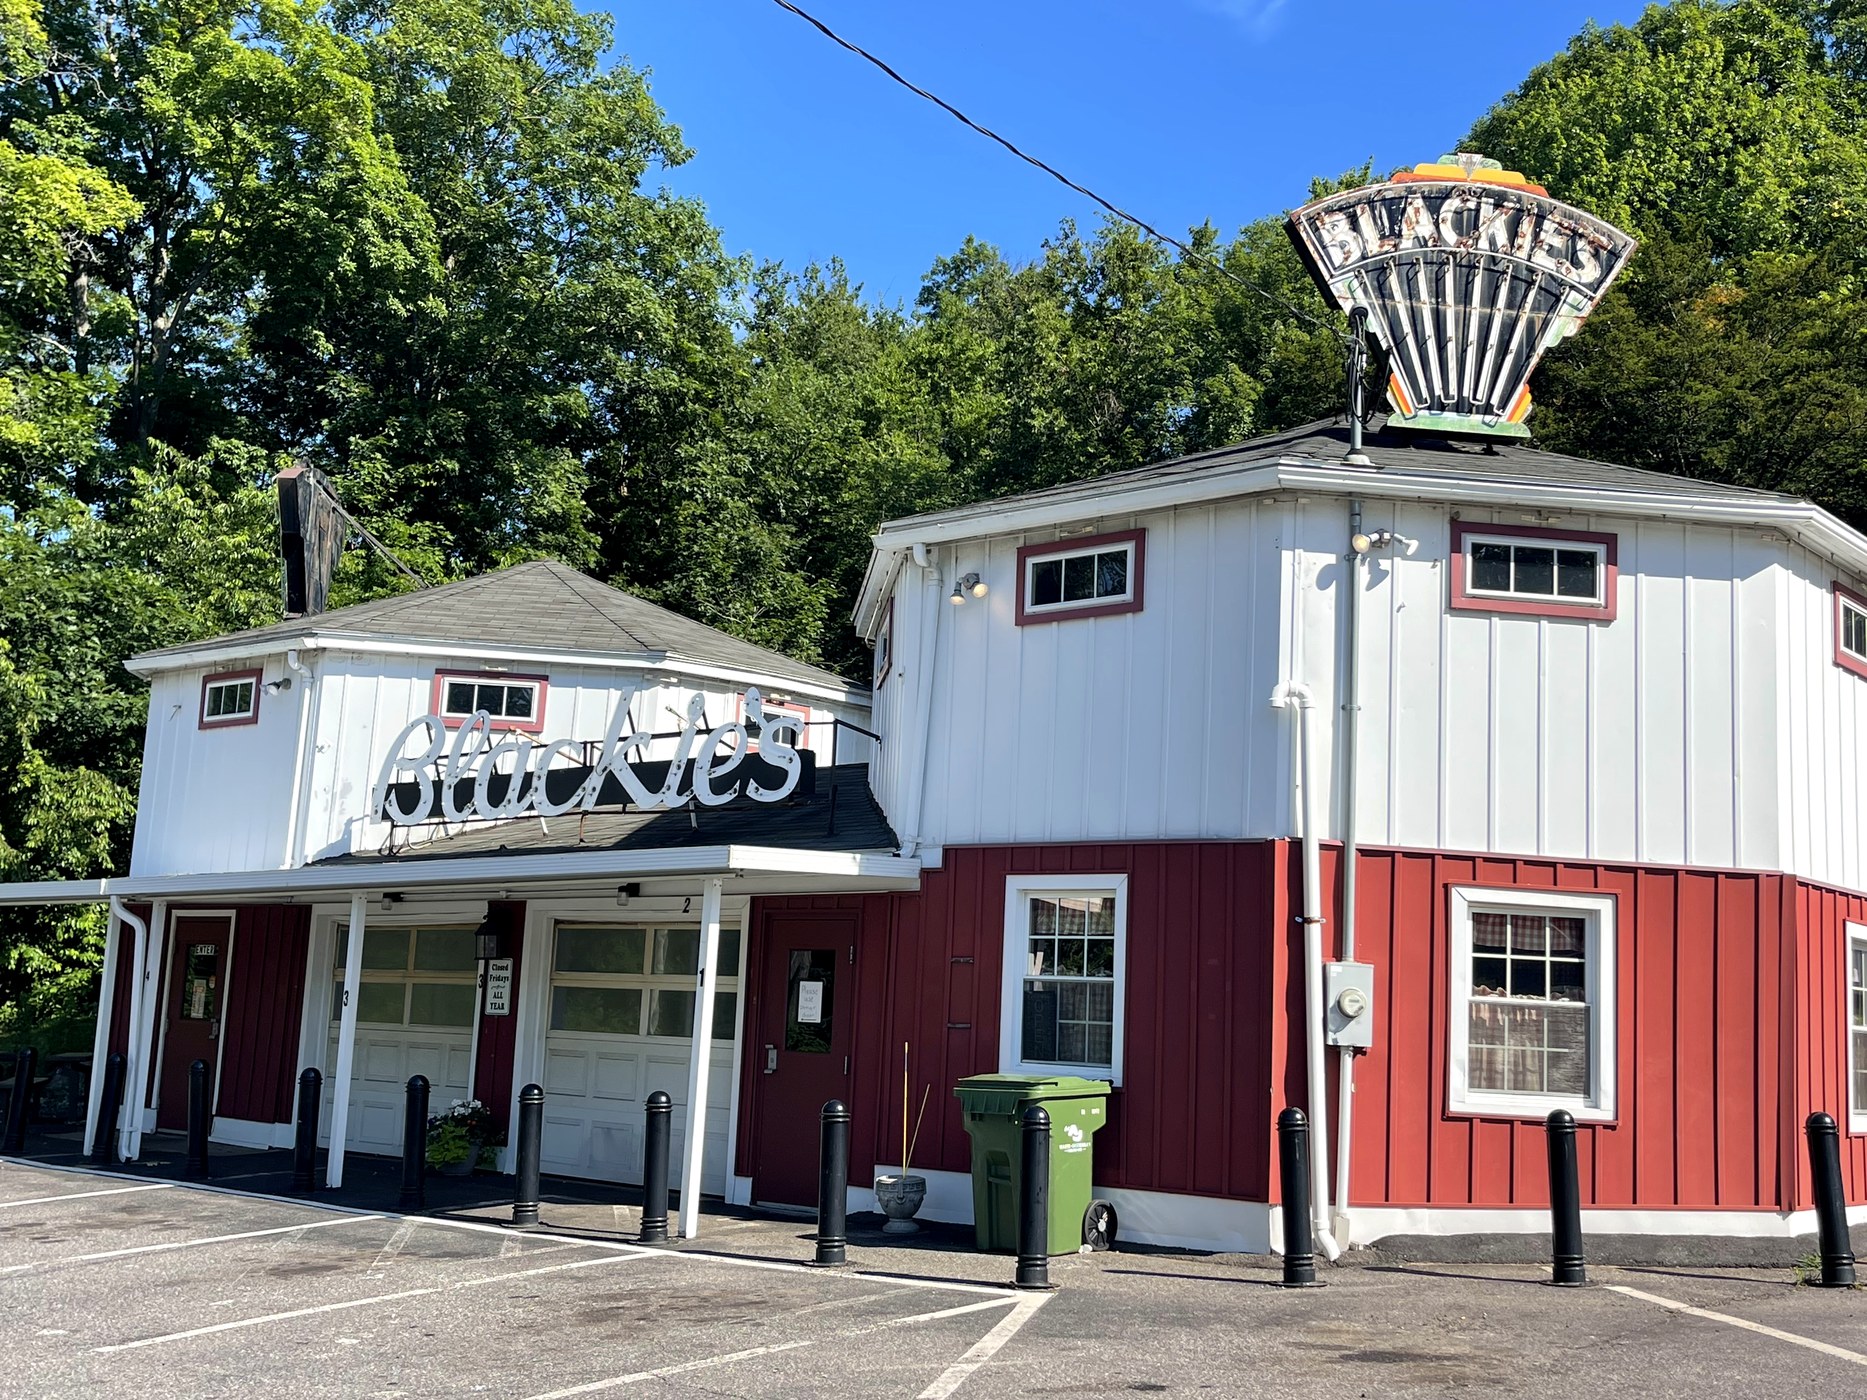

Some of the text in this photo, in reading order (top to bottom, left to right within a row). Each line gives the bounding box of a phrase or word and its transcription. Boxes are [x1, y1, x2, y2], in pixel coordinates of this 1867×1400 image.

[370, 686, 806, 825] Blackie's
[682, 898, 690, 913] 2
[196, 945, 214, 955] ENTER
[478, 974, 484, 988] 3
[489, 975, 509, 983] Fridays
[699, 968, 705, 987] 1
[343, 990, 349, 1006] 3
